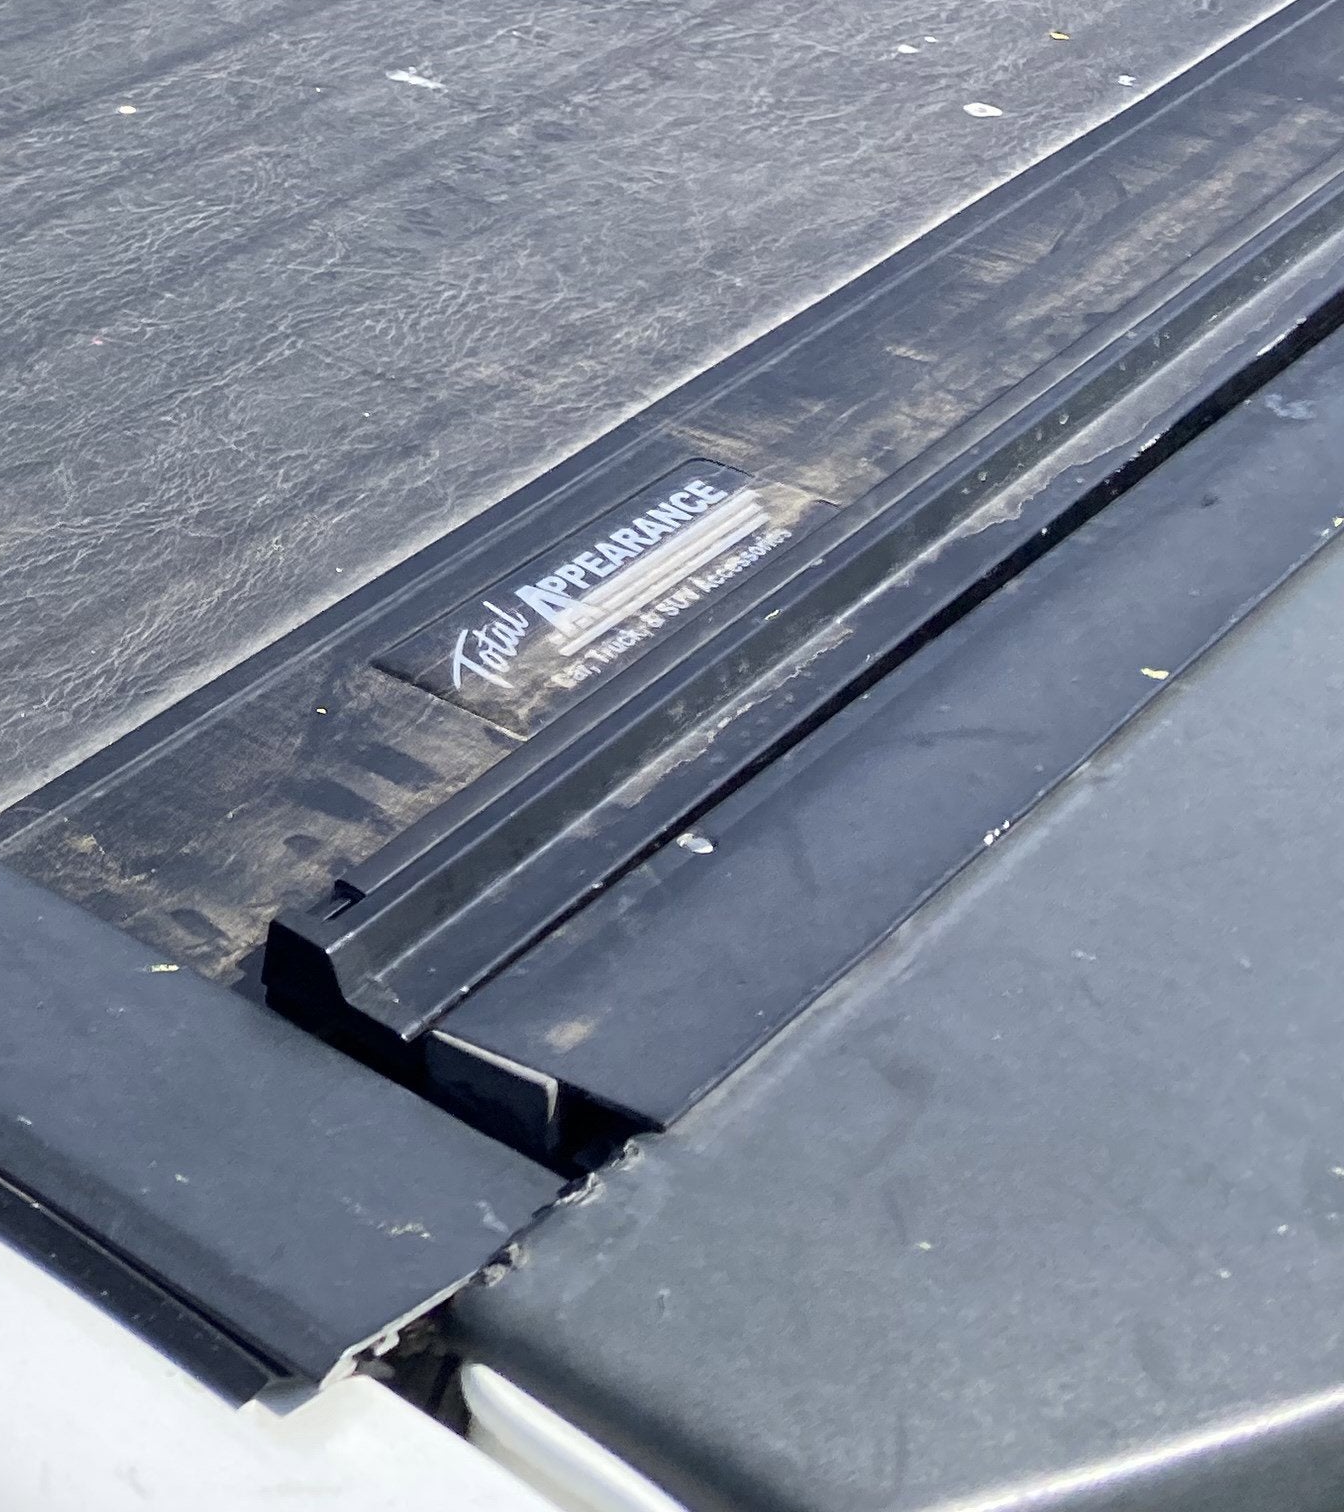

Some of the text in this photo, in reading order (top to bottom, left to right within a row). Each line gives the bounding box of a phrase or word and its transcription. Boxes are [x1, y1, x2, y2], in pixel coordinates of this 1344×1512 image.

[452, 479, 729, 689] Total APPEARANCE
[655, 586, 701, 618] SUV
